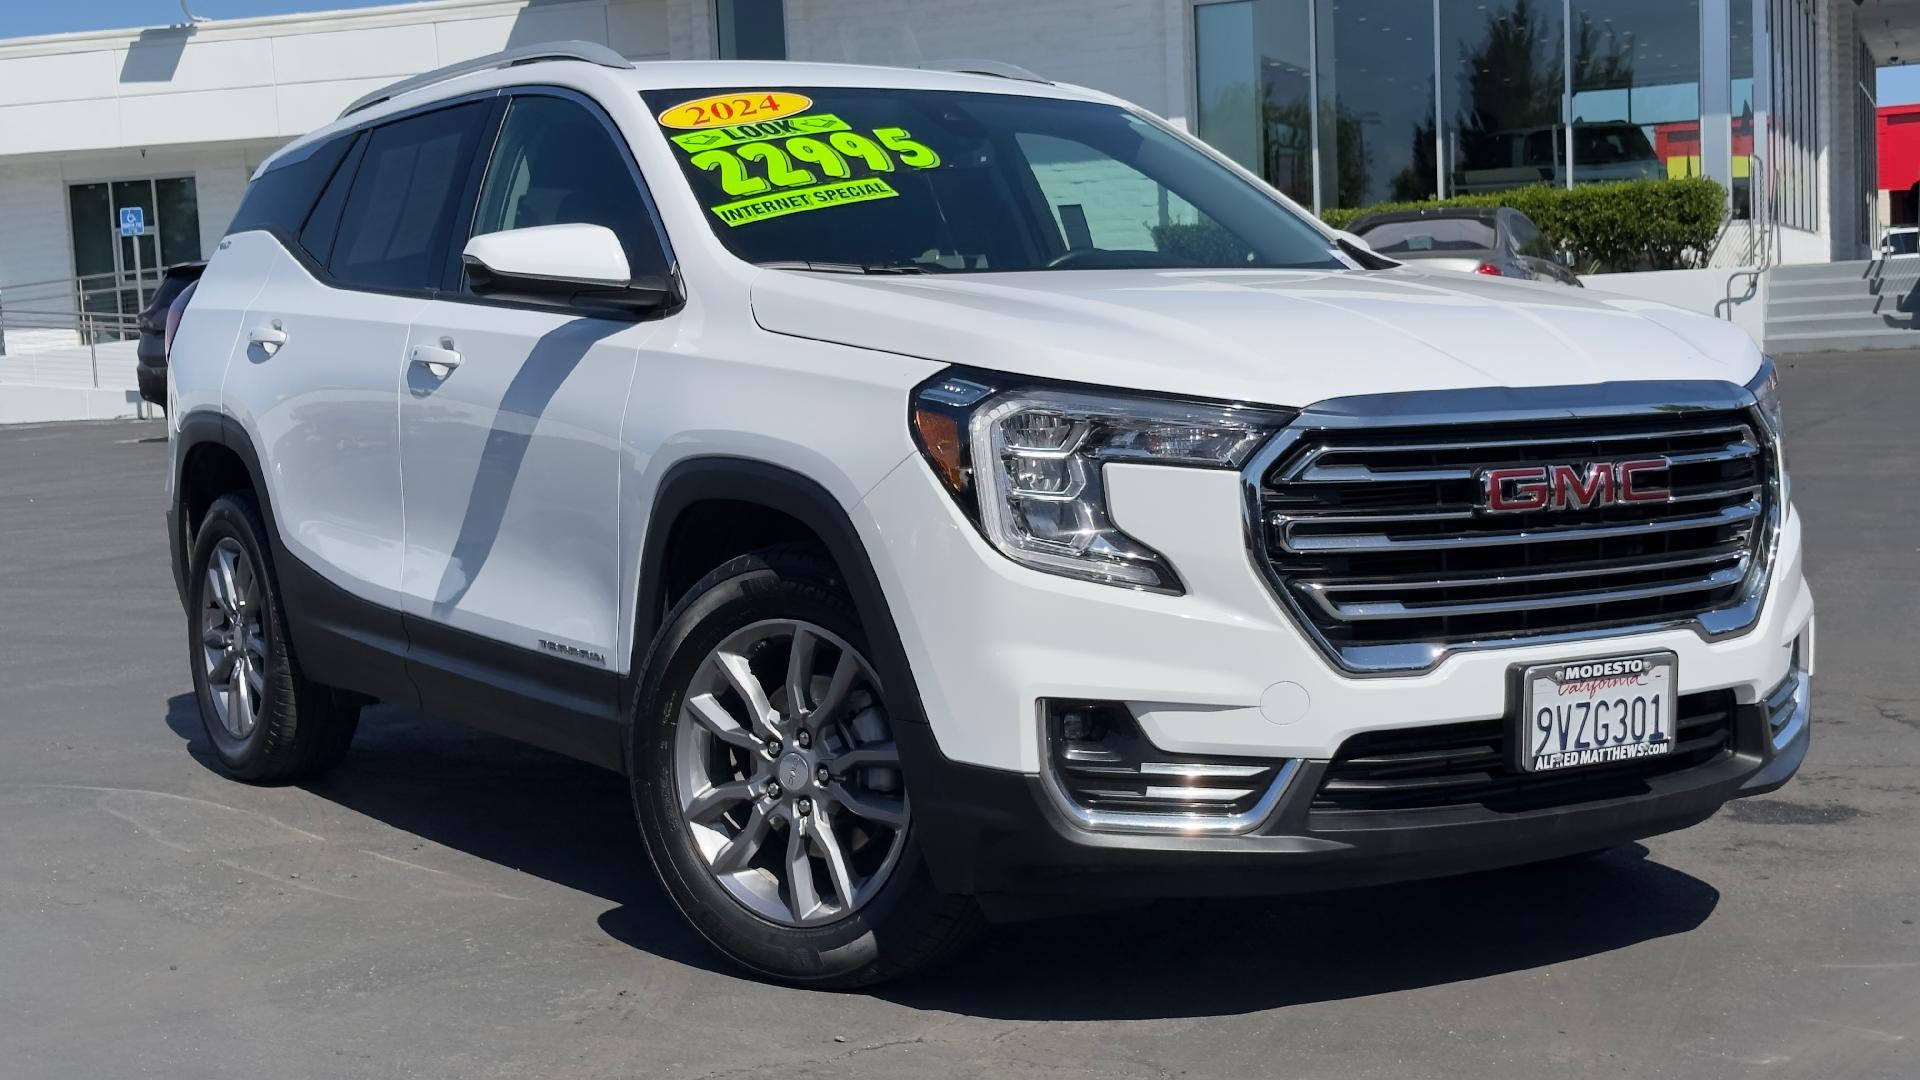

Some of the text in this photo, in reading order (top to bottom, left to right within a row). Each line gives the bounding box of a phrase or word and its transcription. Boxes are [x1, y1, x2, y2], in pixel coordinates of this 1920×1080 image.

[685, 94, 780, 126] 2024
[723, 119, 800, 141] LOOK
[690, 127, 941, 196] 22995
[720, 181, 889, 222] INTERNET SPECIAL
[1481, 456, 1672, 513] GMC
[1565, 659, 1643, 681] MODESTO
[1534, 694, 1664, 756] 9VZG301
